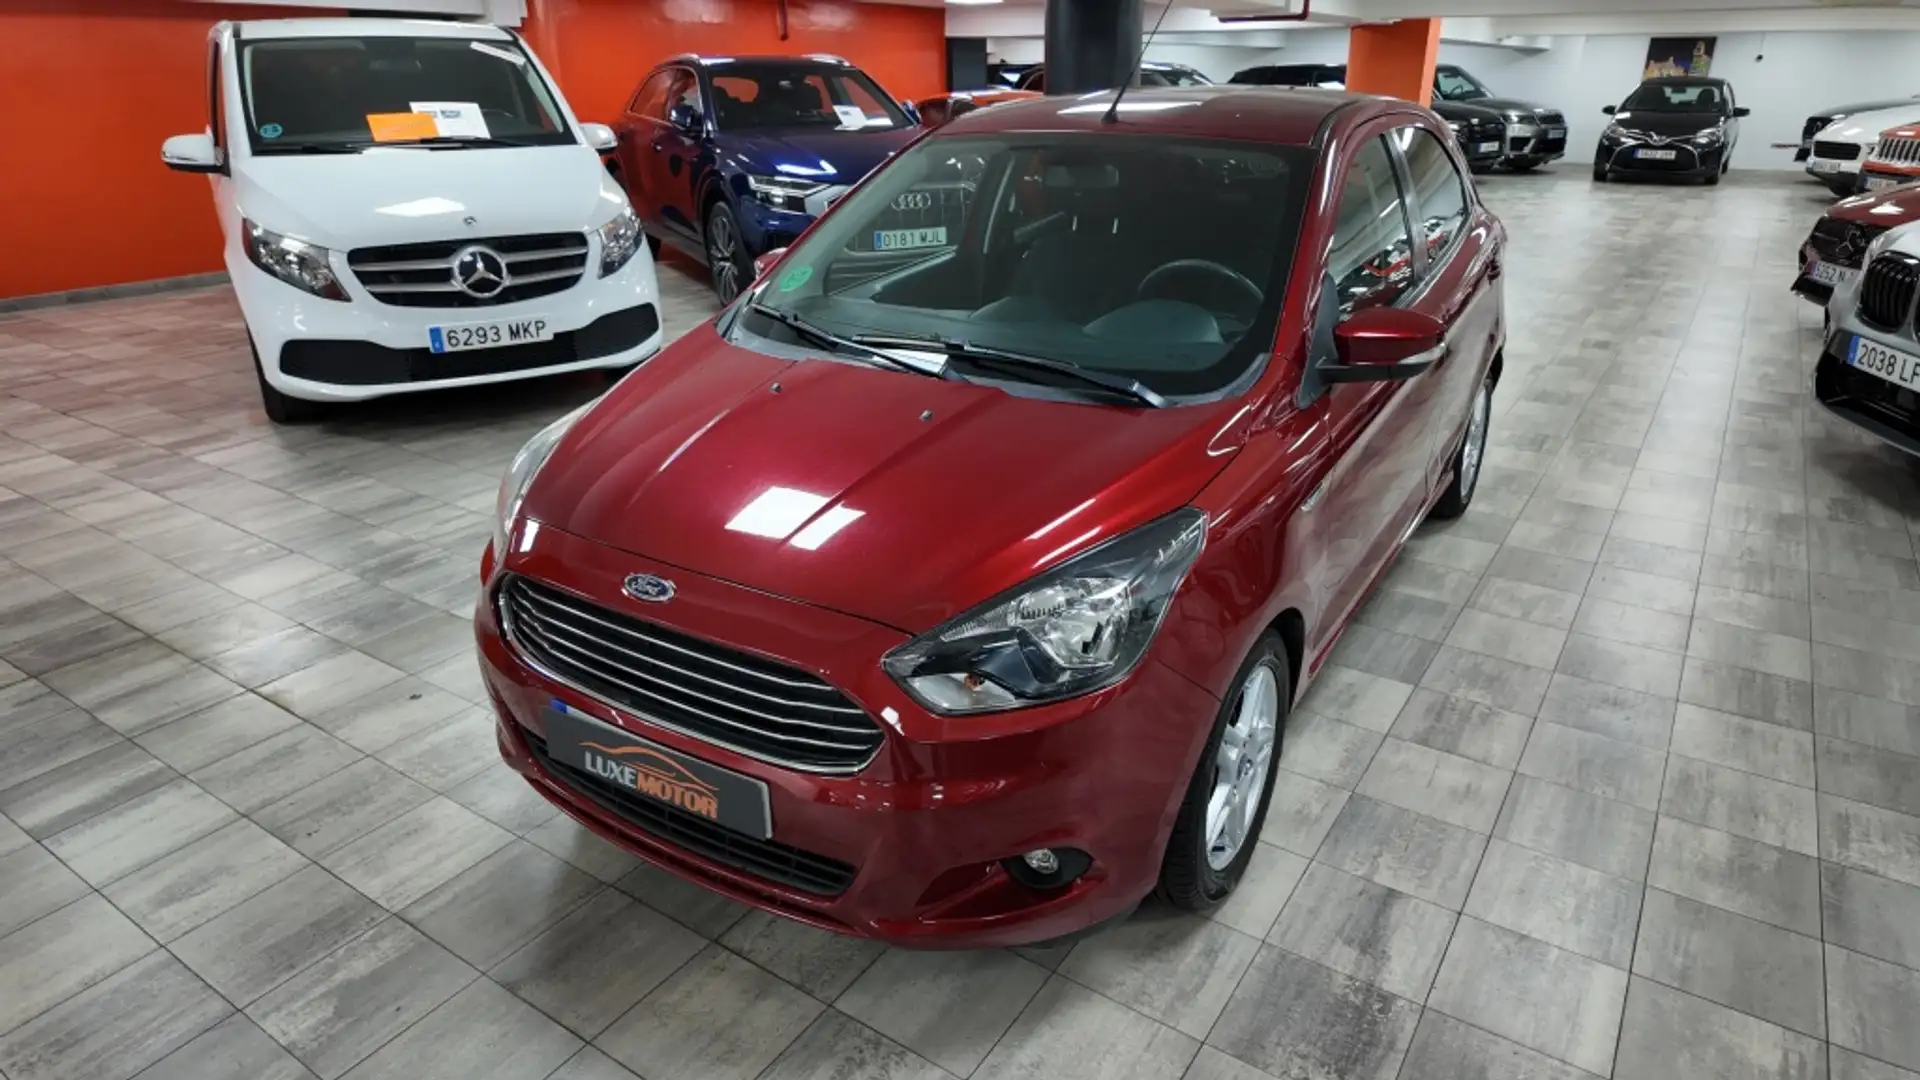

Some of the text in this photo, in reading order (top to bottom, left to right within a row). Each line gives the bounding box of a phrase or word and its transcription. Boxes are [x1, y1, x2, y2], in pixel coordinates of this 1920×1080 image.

[883, 232, 915, 246] 0181
[446, 320, 546, 347] 6293 MKP
[1858, 343, 1898, 376] 2038
